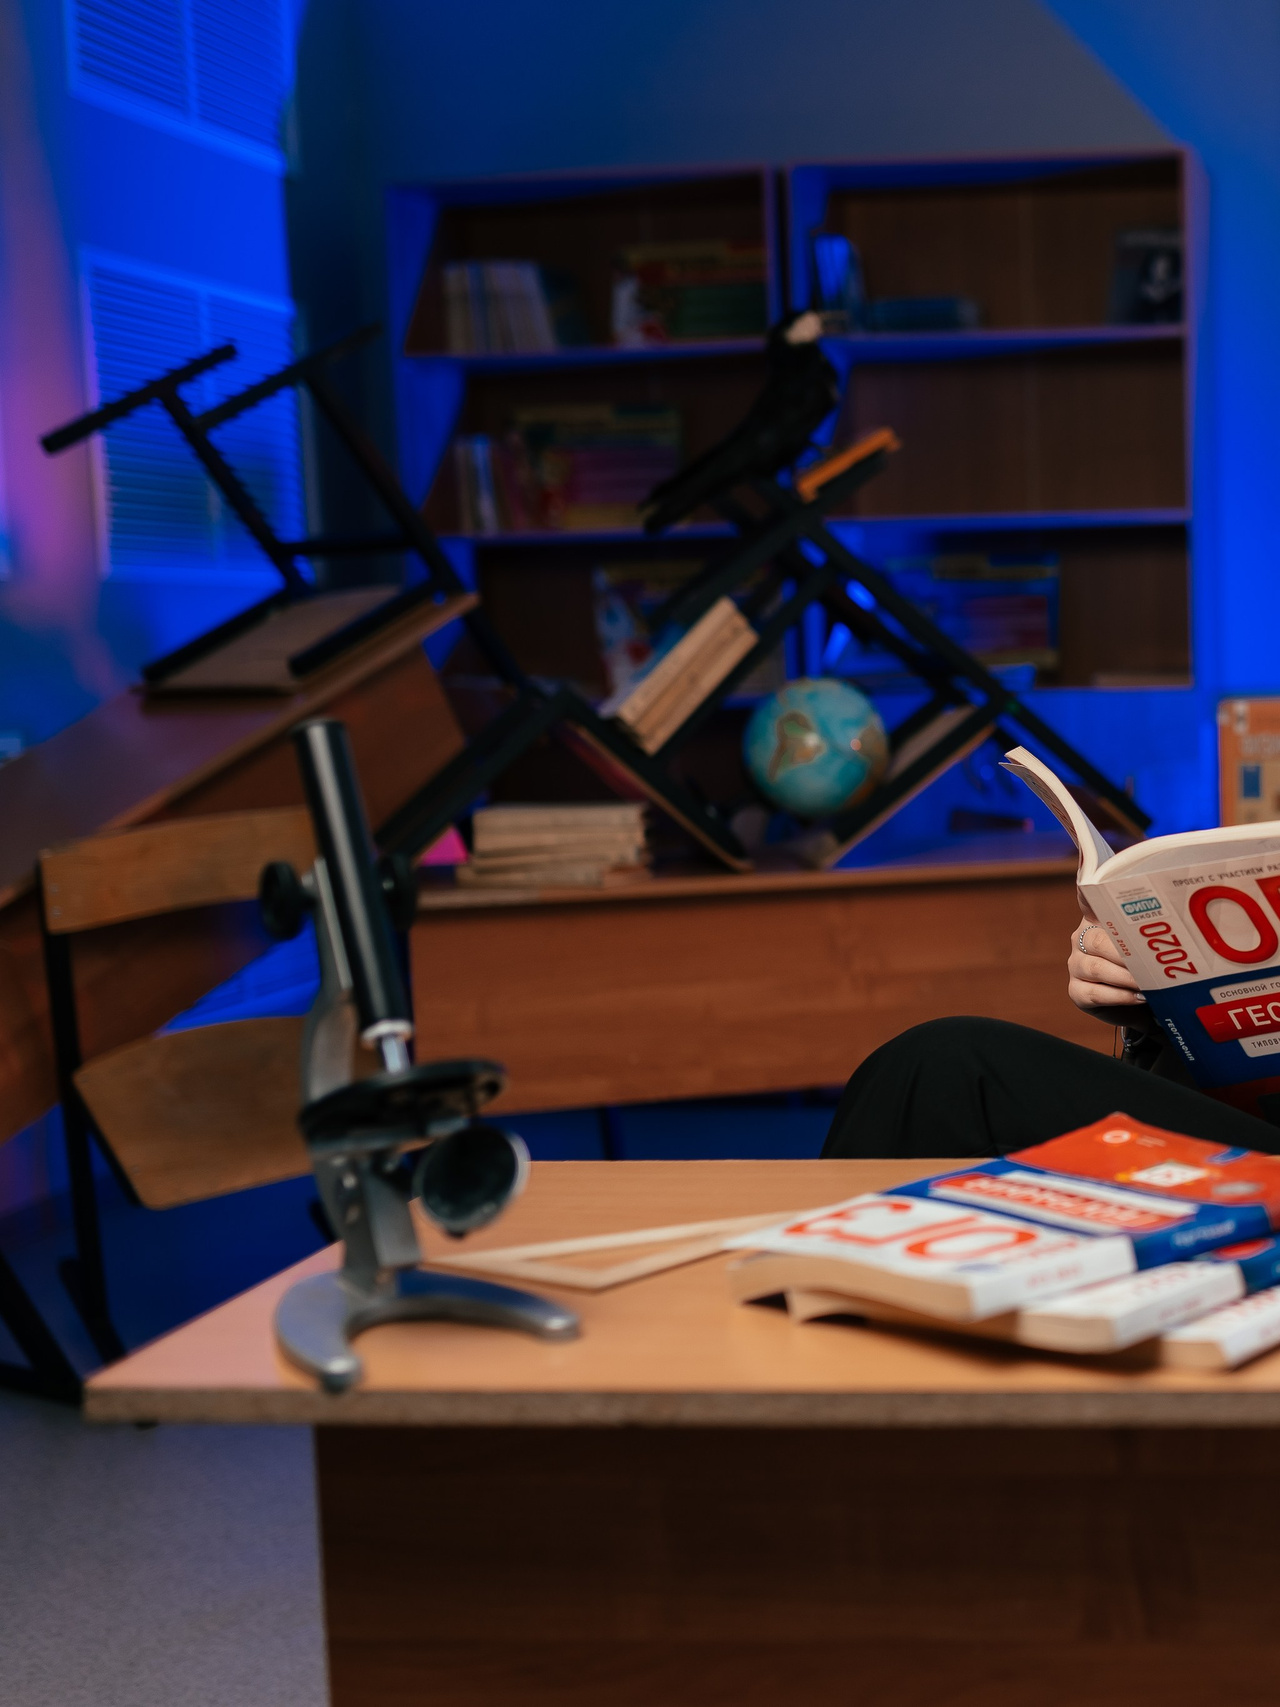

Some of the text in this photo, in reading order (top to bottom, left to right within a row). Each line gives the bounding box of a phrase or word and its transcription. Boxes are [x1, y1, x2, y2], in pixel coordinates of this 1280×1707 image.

[1172, 876, 1206, 888] ПРОЕКТ
[1209, 873, 1216, 882] С
[1217, 866, 1264, 881] УЧАСТИЕМ
[1124, 899, 1160, 914] ФИПИ
[1130, 911, 1163, 922] ШКОЛЕ
[1106, 921, 1131, 957] ОГЭ 2020
[1139, 921, 1198, 979] 2020
[1219, 983, 1267, 999] ОСНОВНОЙ
[1165, 1018, 1195, 1061] ГЕОГРАФИЯ
